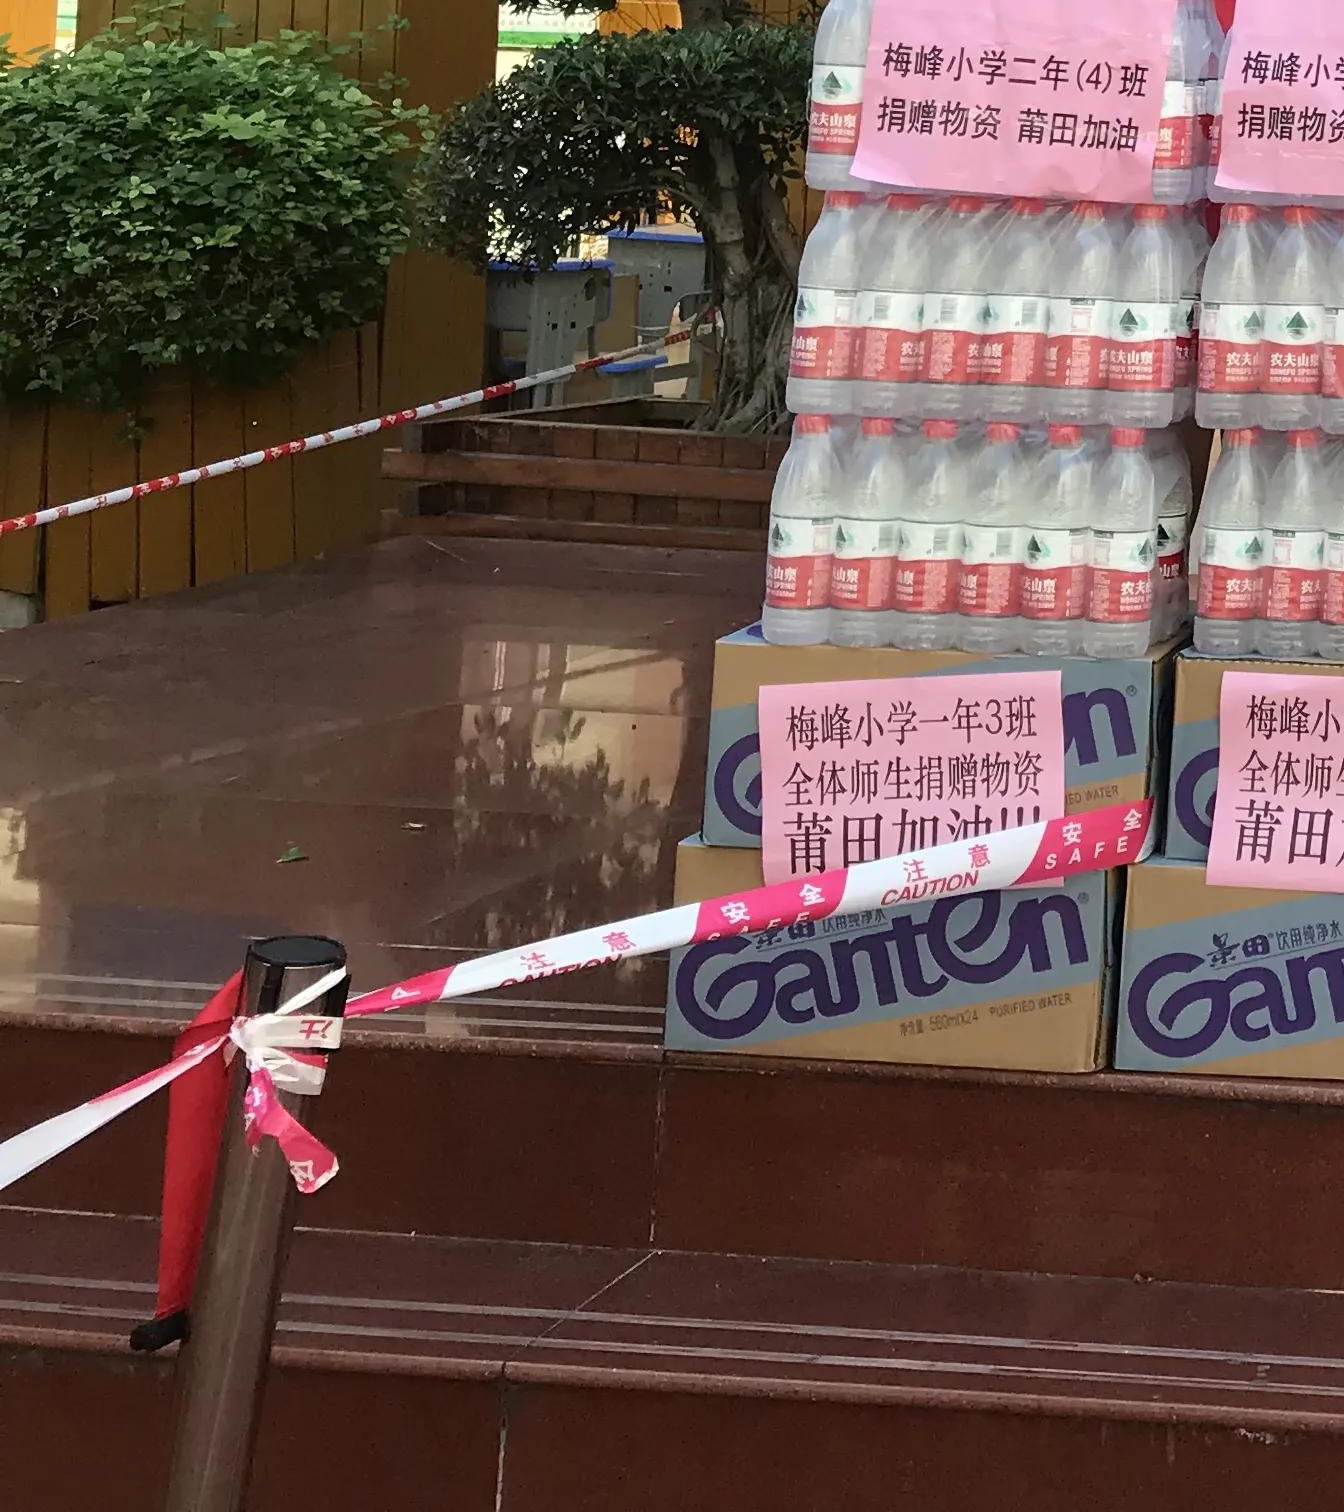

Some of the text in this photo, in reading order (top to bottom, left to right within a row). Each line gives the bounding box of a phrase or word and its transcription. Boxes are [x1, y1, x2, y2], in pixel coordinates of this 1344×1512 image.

[883, 43, 1148, 97] 梅峰小学二年(4)班
[878, 96, 1140, 152] 捐赠物资 莆田加油
[786, 695, 1037, 751] 梅峰小学一年3班
[783, 751, 1043, 806] 全体师生捐赠物资
[1044, 835, 1129, 871] SAFE
[880, 871, 979, 906] CAUTION
[1275, 919, 1344, 951] 饮用纯净水
[675, 889, 1089, 1039] Ganten
[989, 992, 1072, 1018] PURIFIED WATER
